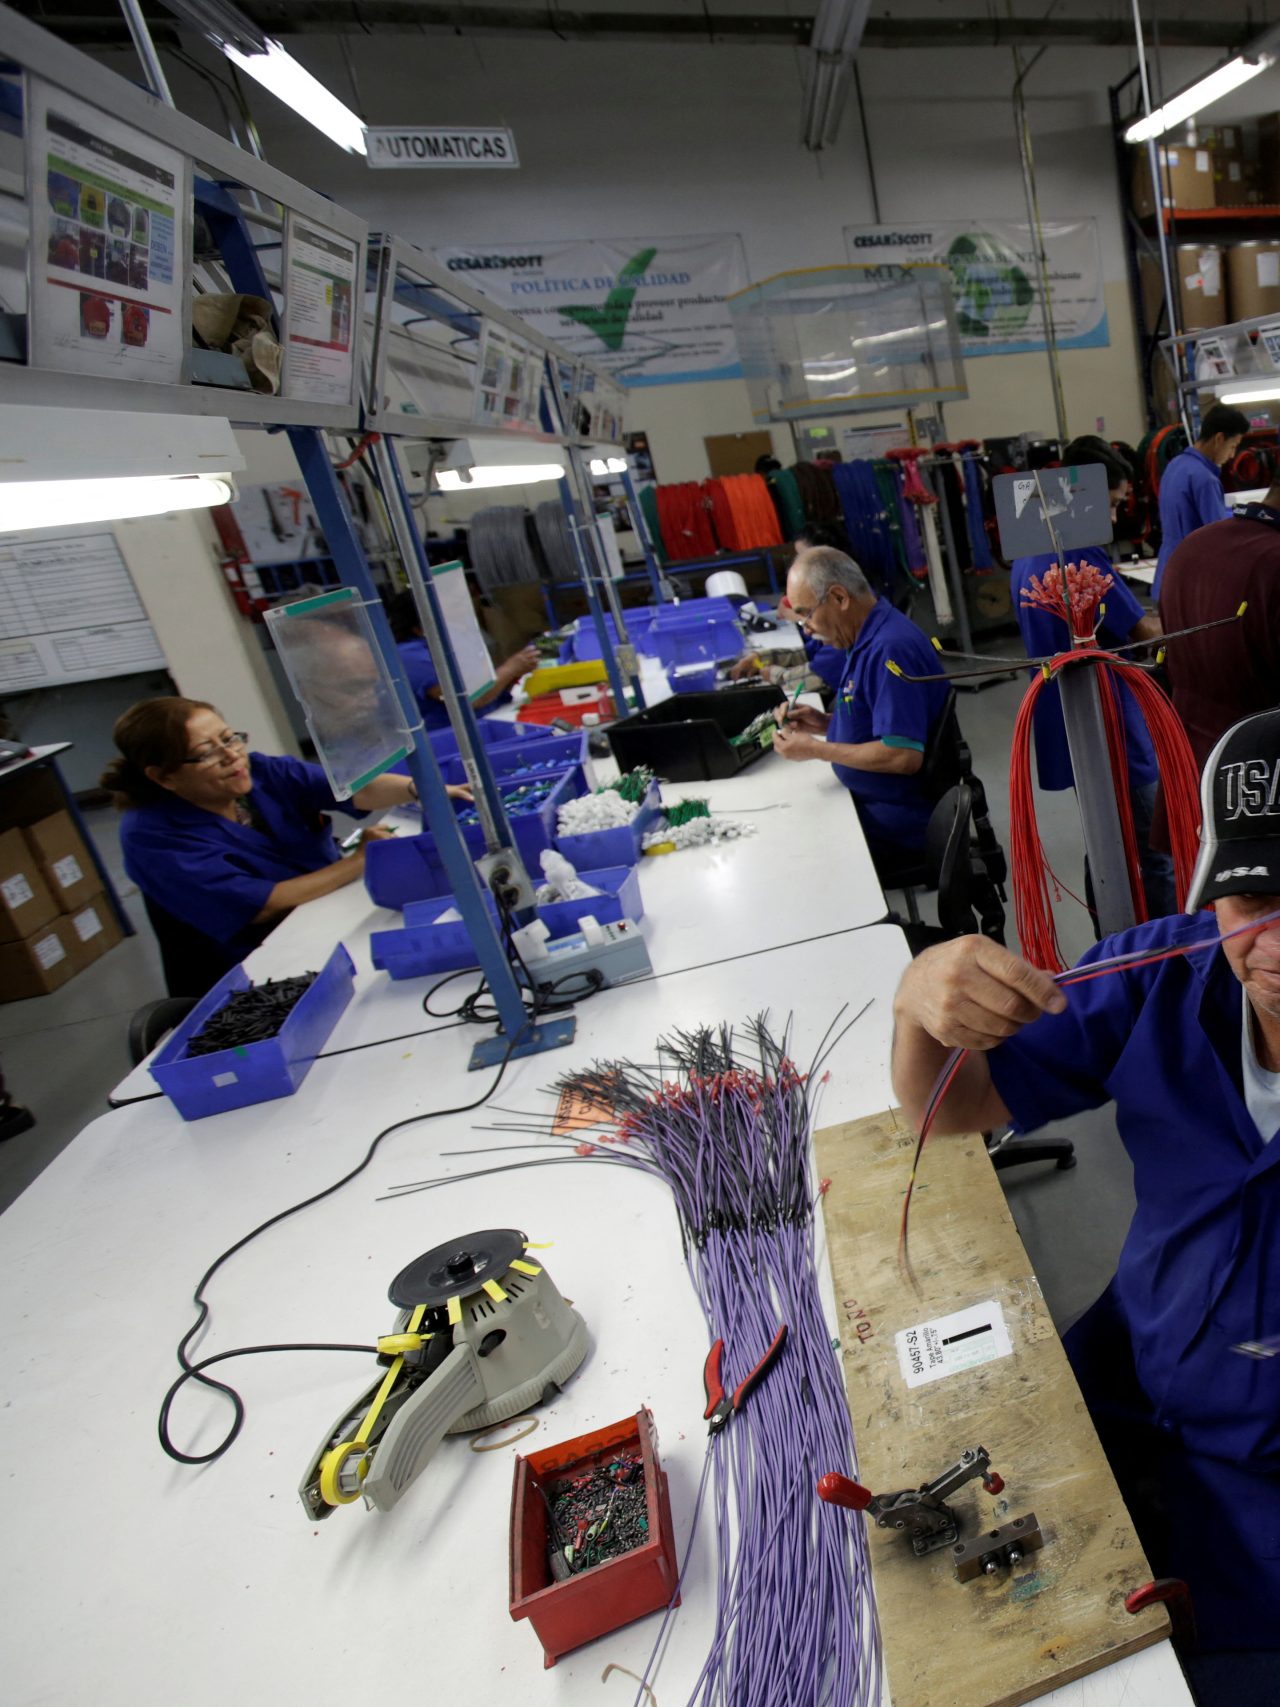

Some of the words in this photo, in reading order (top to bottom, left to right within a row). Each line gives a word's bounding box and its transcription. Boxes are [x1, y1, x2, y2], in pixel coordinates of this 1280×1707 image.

[1214, 866, 1270, 882] USA
[906, 1330, 924, 1374] 90457-S2
[929, 1352, 937, 1369] Tape
